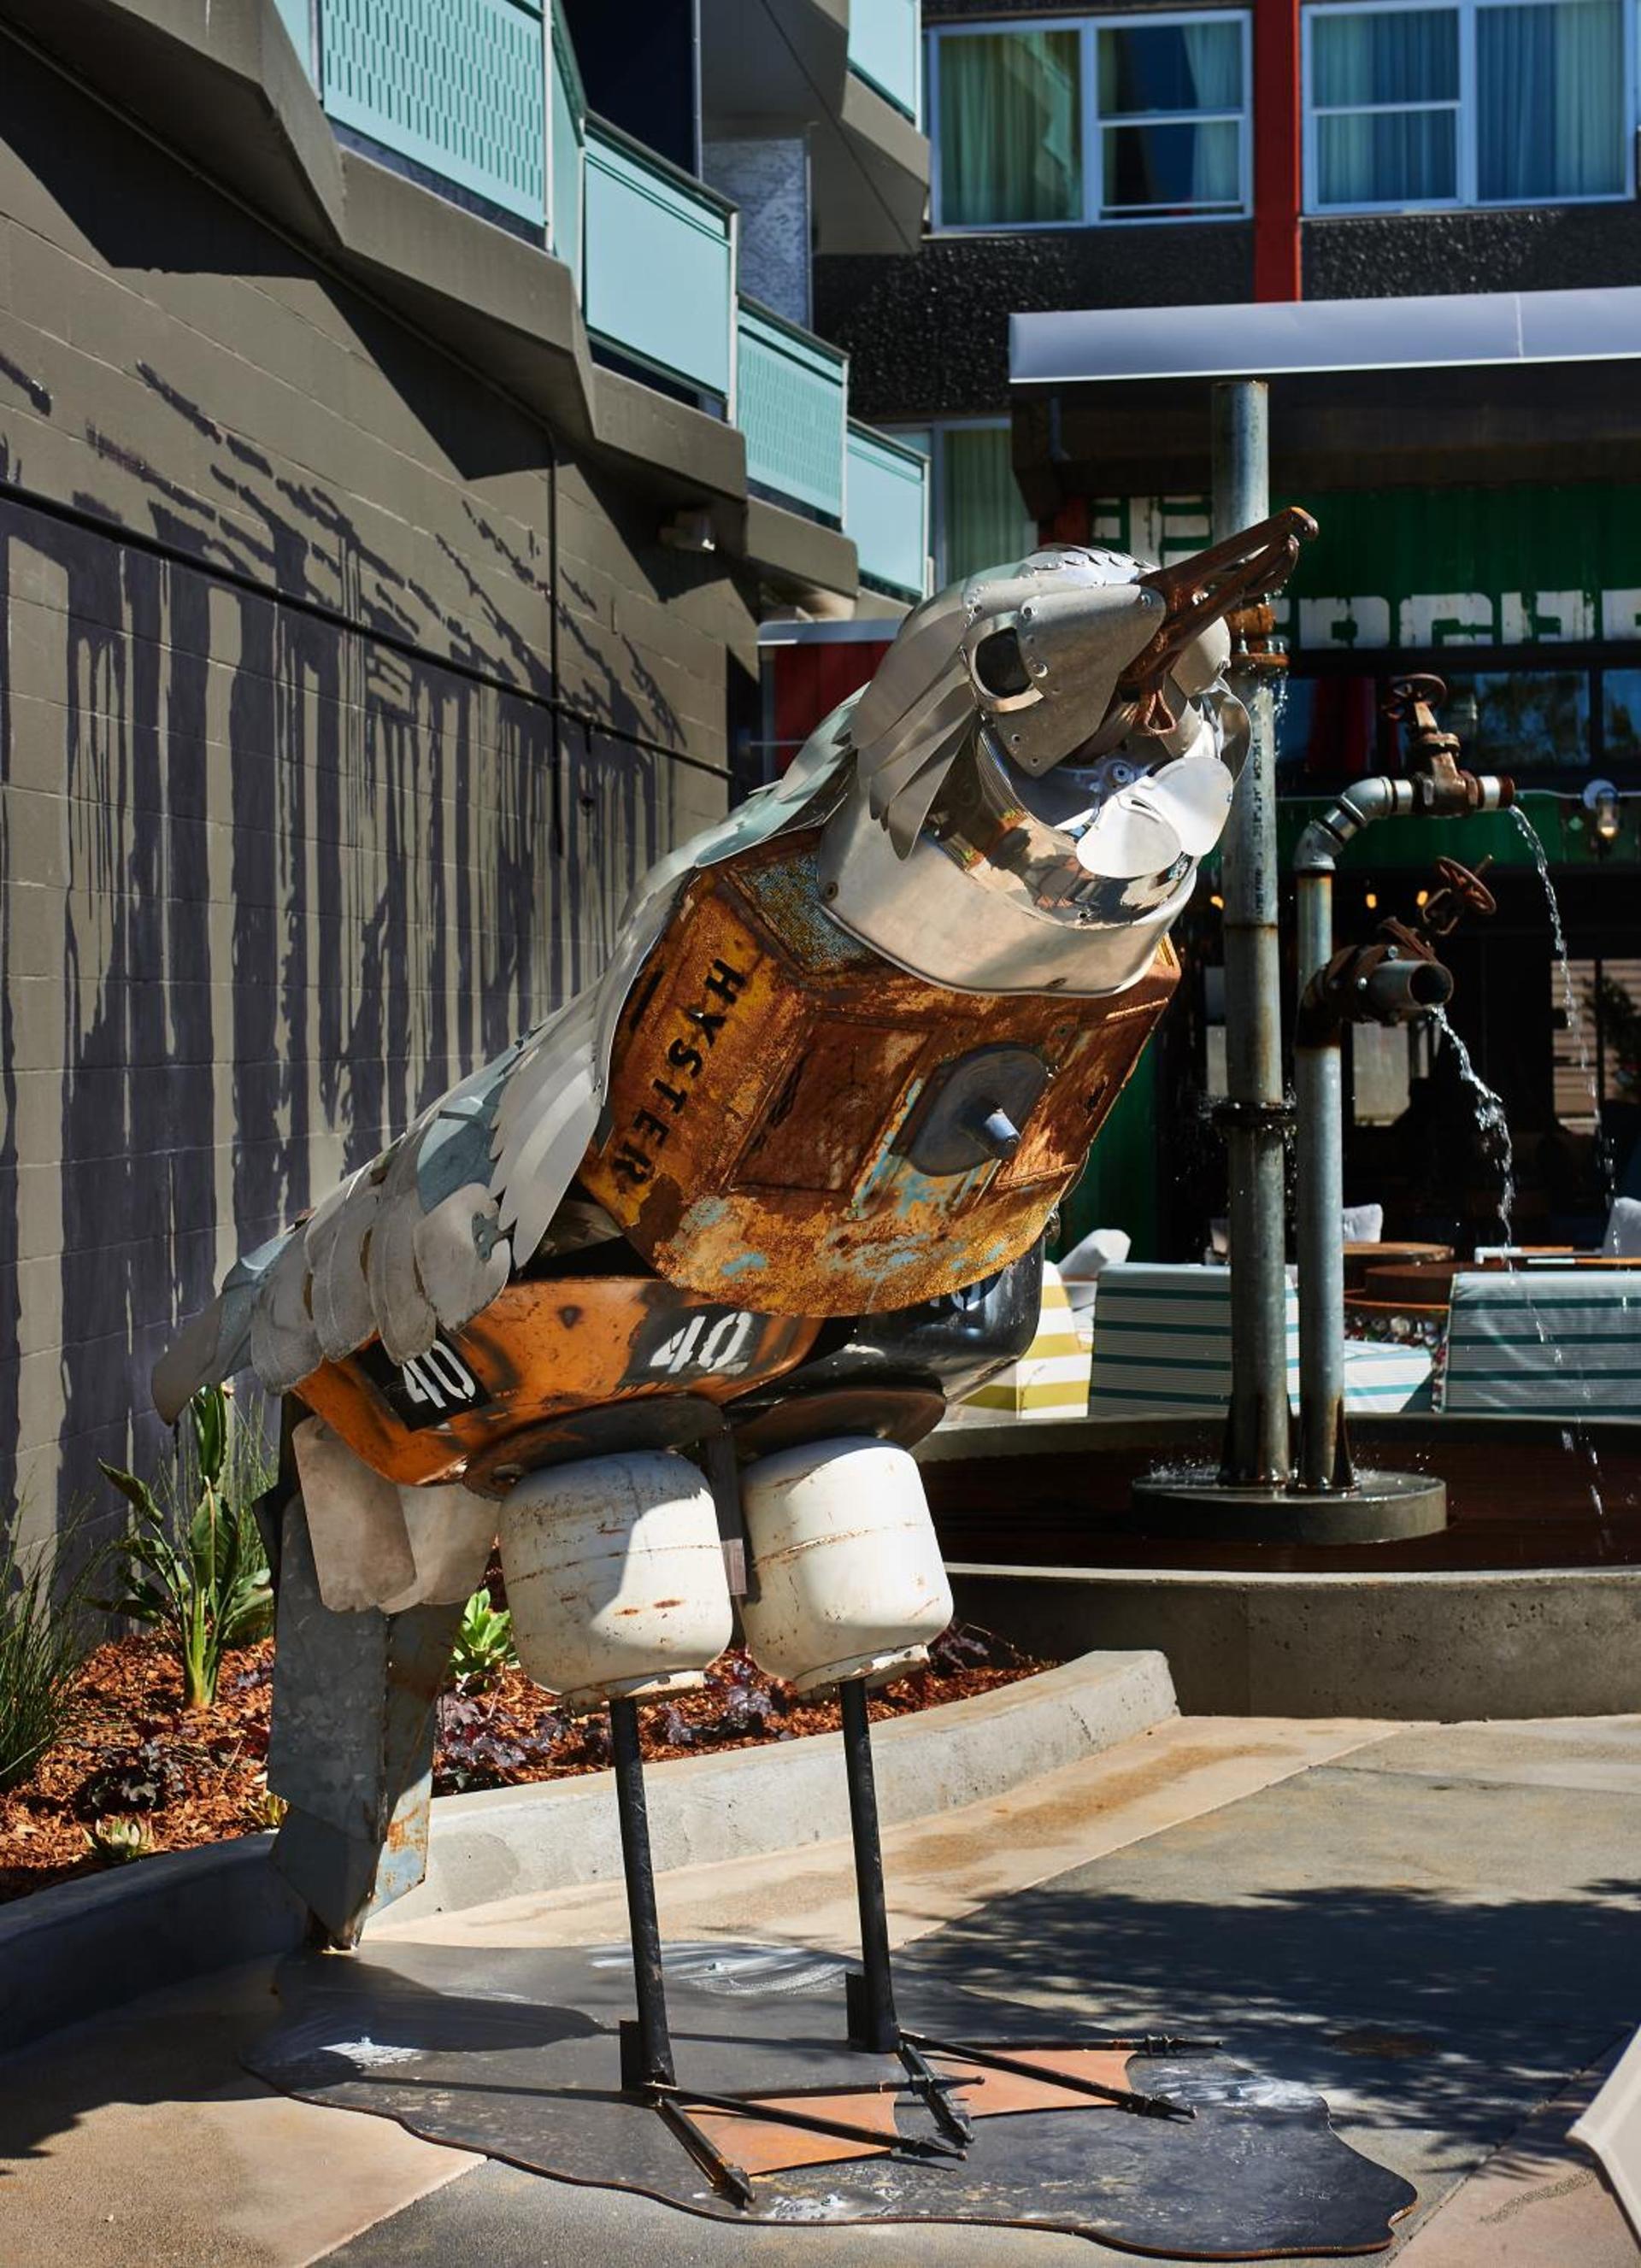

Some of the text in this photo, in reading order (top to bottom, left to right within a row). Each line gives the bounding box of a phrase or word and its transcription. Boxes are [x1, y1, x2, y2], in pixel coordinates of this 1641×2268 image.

[613, 958, 746, 1184] HYSTER
[401, 1339, 476, 1409] 40
[650, 1311, 753, 1374] 40
